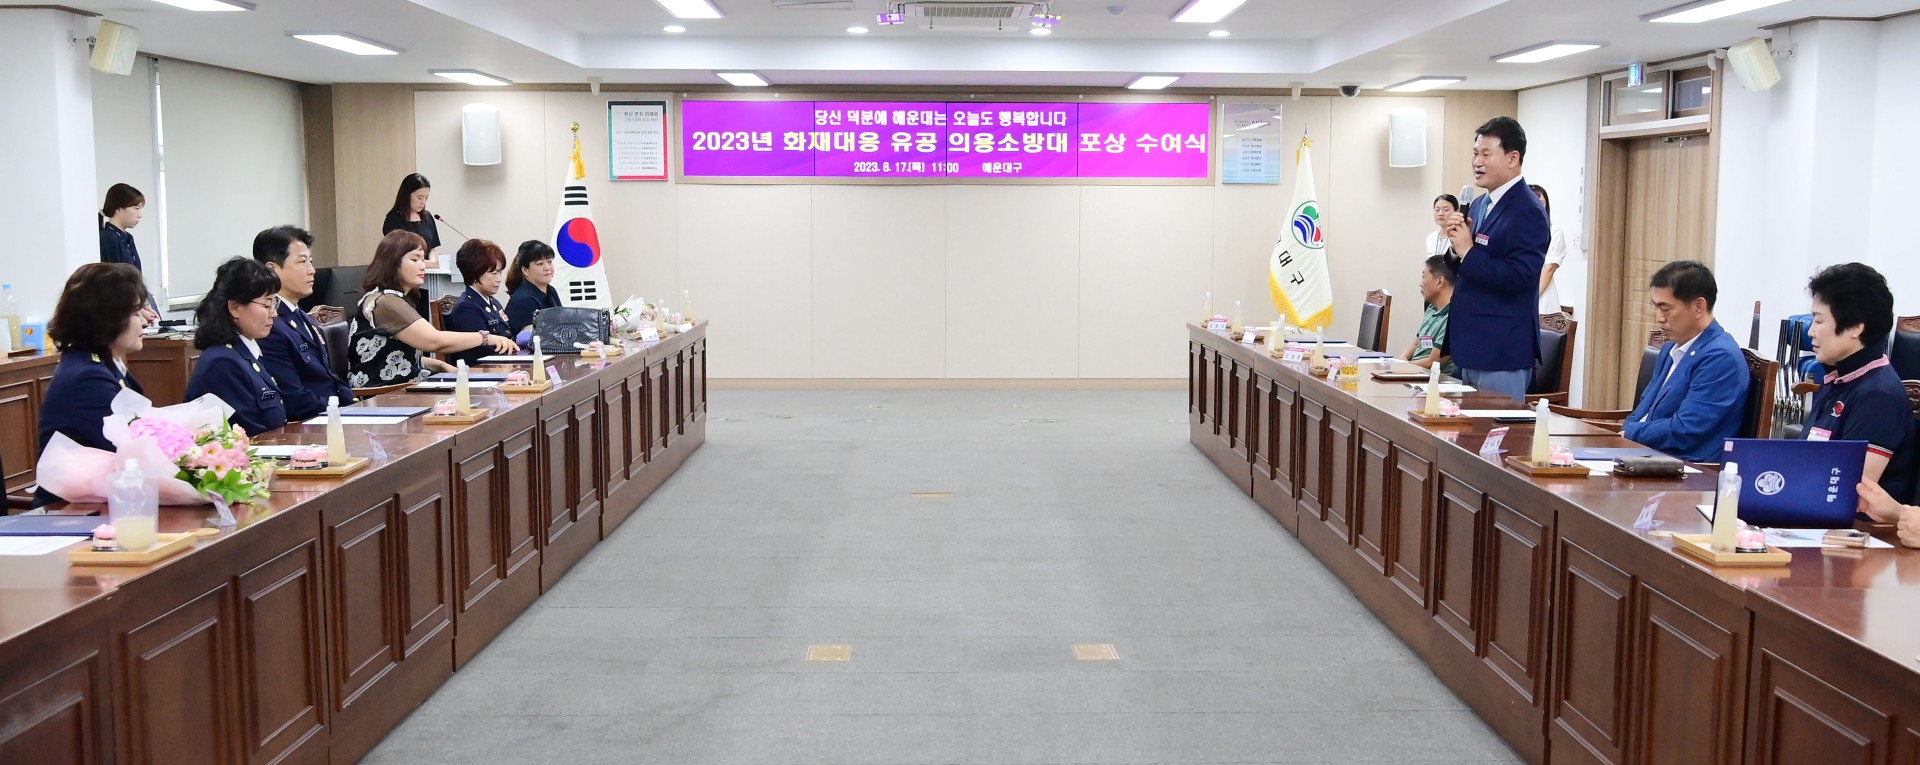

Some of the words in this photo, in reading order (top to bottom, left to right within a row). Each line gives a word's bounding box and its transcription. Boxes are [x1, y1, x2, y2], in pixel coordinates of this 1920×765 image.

[815, 109, 842, 126] 당신
[847, 109, 888, 127] 덕분에
[892, 110, 947, 127] 해운대는
[953, 110, 994, 127] 오늘도
[998, 110, 1067, 127] 행복합니다
[692, 131, 773, 152] 2023년
[783, 131, 881, 153] 화재대응
[890, 132, 938, 153] 유공
[948, 132, 1068, 154] 의용소방대
[1079, 133, 1127, 154] 포상
[1135, 133, 1206, 154] 수여식
[853, 161, 880, 173] 2023.
[882, 161, 892, 173] 8.
[895, 161, 925, 173] 17.(목)
[931, 162, 959, 174] 11:00
[981, 161, 1023, 174] 해운대구
[1278, 242, 1305, 285] 대구
[1826, 467, 1841, 503] 해운대구
